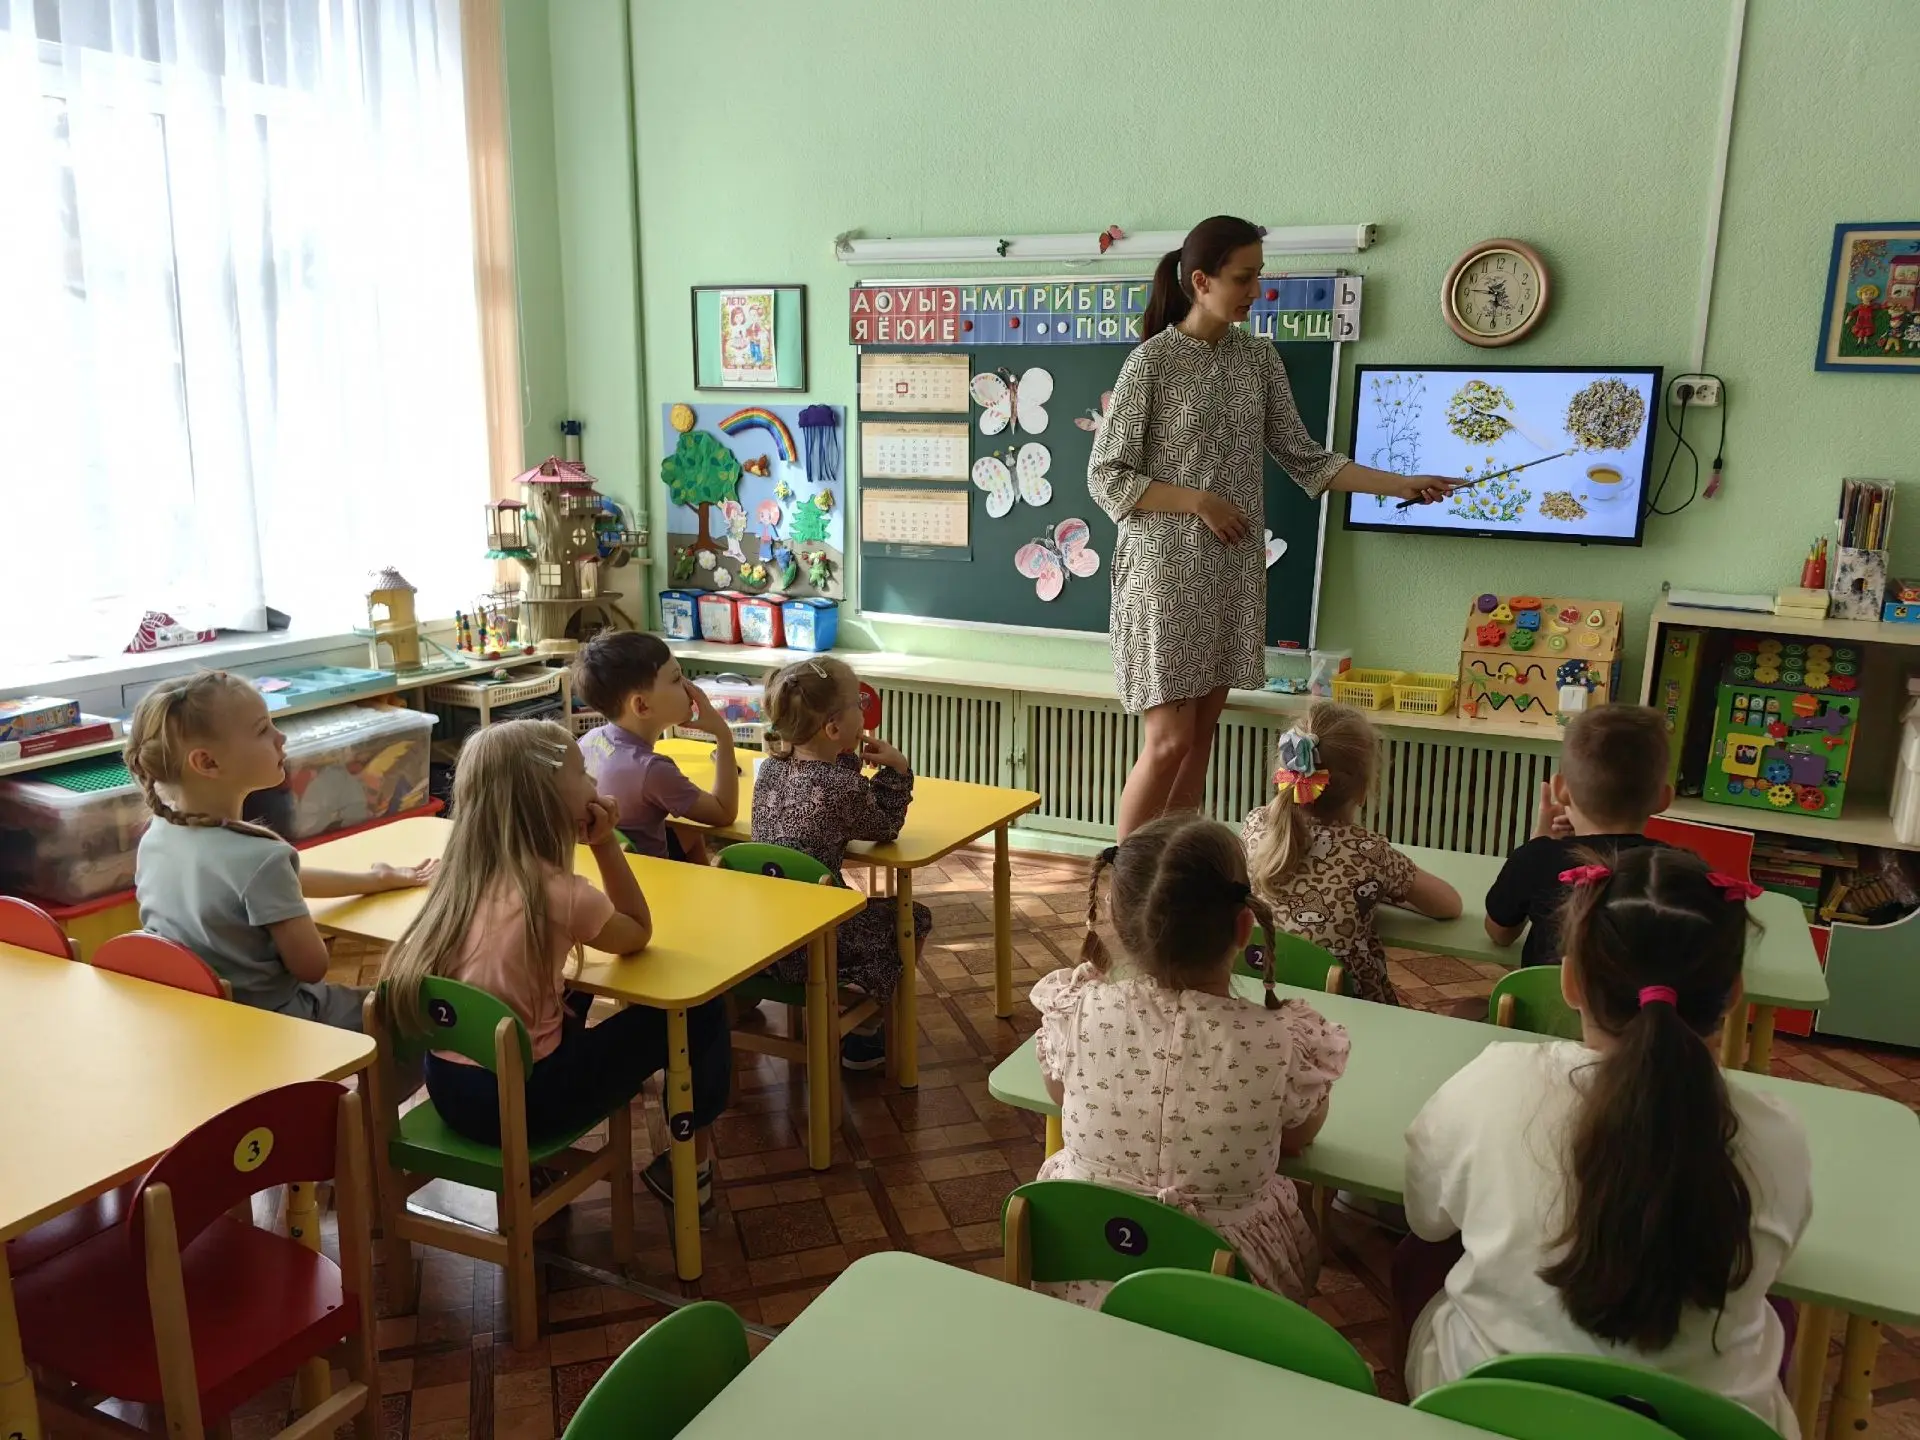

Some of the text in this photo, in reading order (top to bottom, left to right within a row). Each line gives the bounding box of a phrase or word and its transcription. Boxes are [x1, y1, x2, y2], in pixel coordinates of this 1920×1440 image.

[1481, 261, 1489, 274] 11
[1496, 258, 1506, 270] 12
[1513, 262, 1517, 274] 1
[1469, 273, 1478, 284] 10
[1521, 273, 1529, 285] 2
[1464, 287, 1470, 298] 9
[1524, 288, 1531, 300] 3
[1465, 303, 1472, 314] 8
[1518, 304, 1524, 316] 4
[1476, 313, 1483, 325] 7
[1505, 314, 1512, 326] 5
[1254, 950, 1263, 966] 2
[437, 1006, 449, 1023] 2
[680, 1119, 690, 1135] 2
[247, 1139, 260, 1163] 3
[1119, 1226, 1133, 1248] 2
